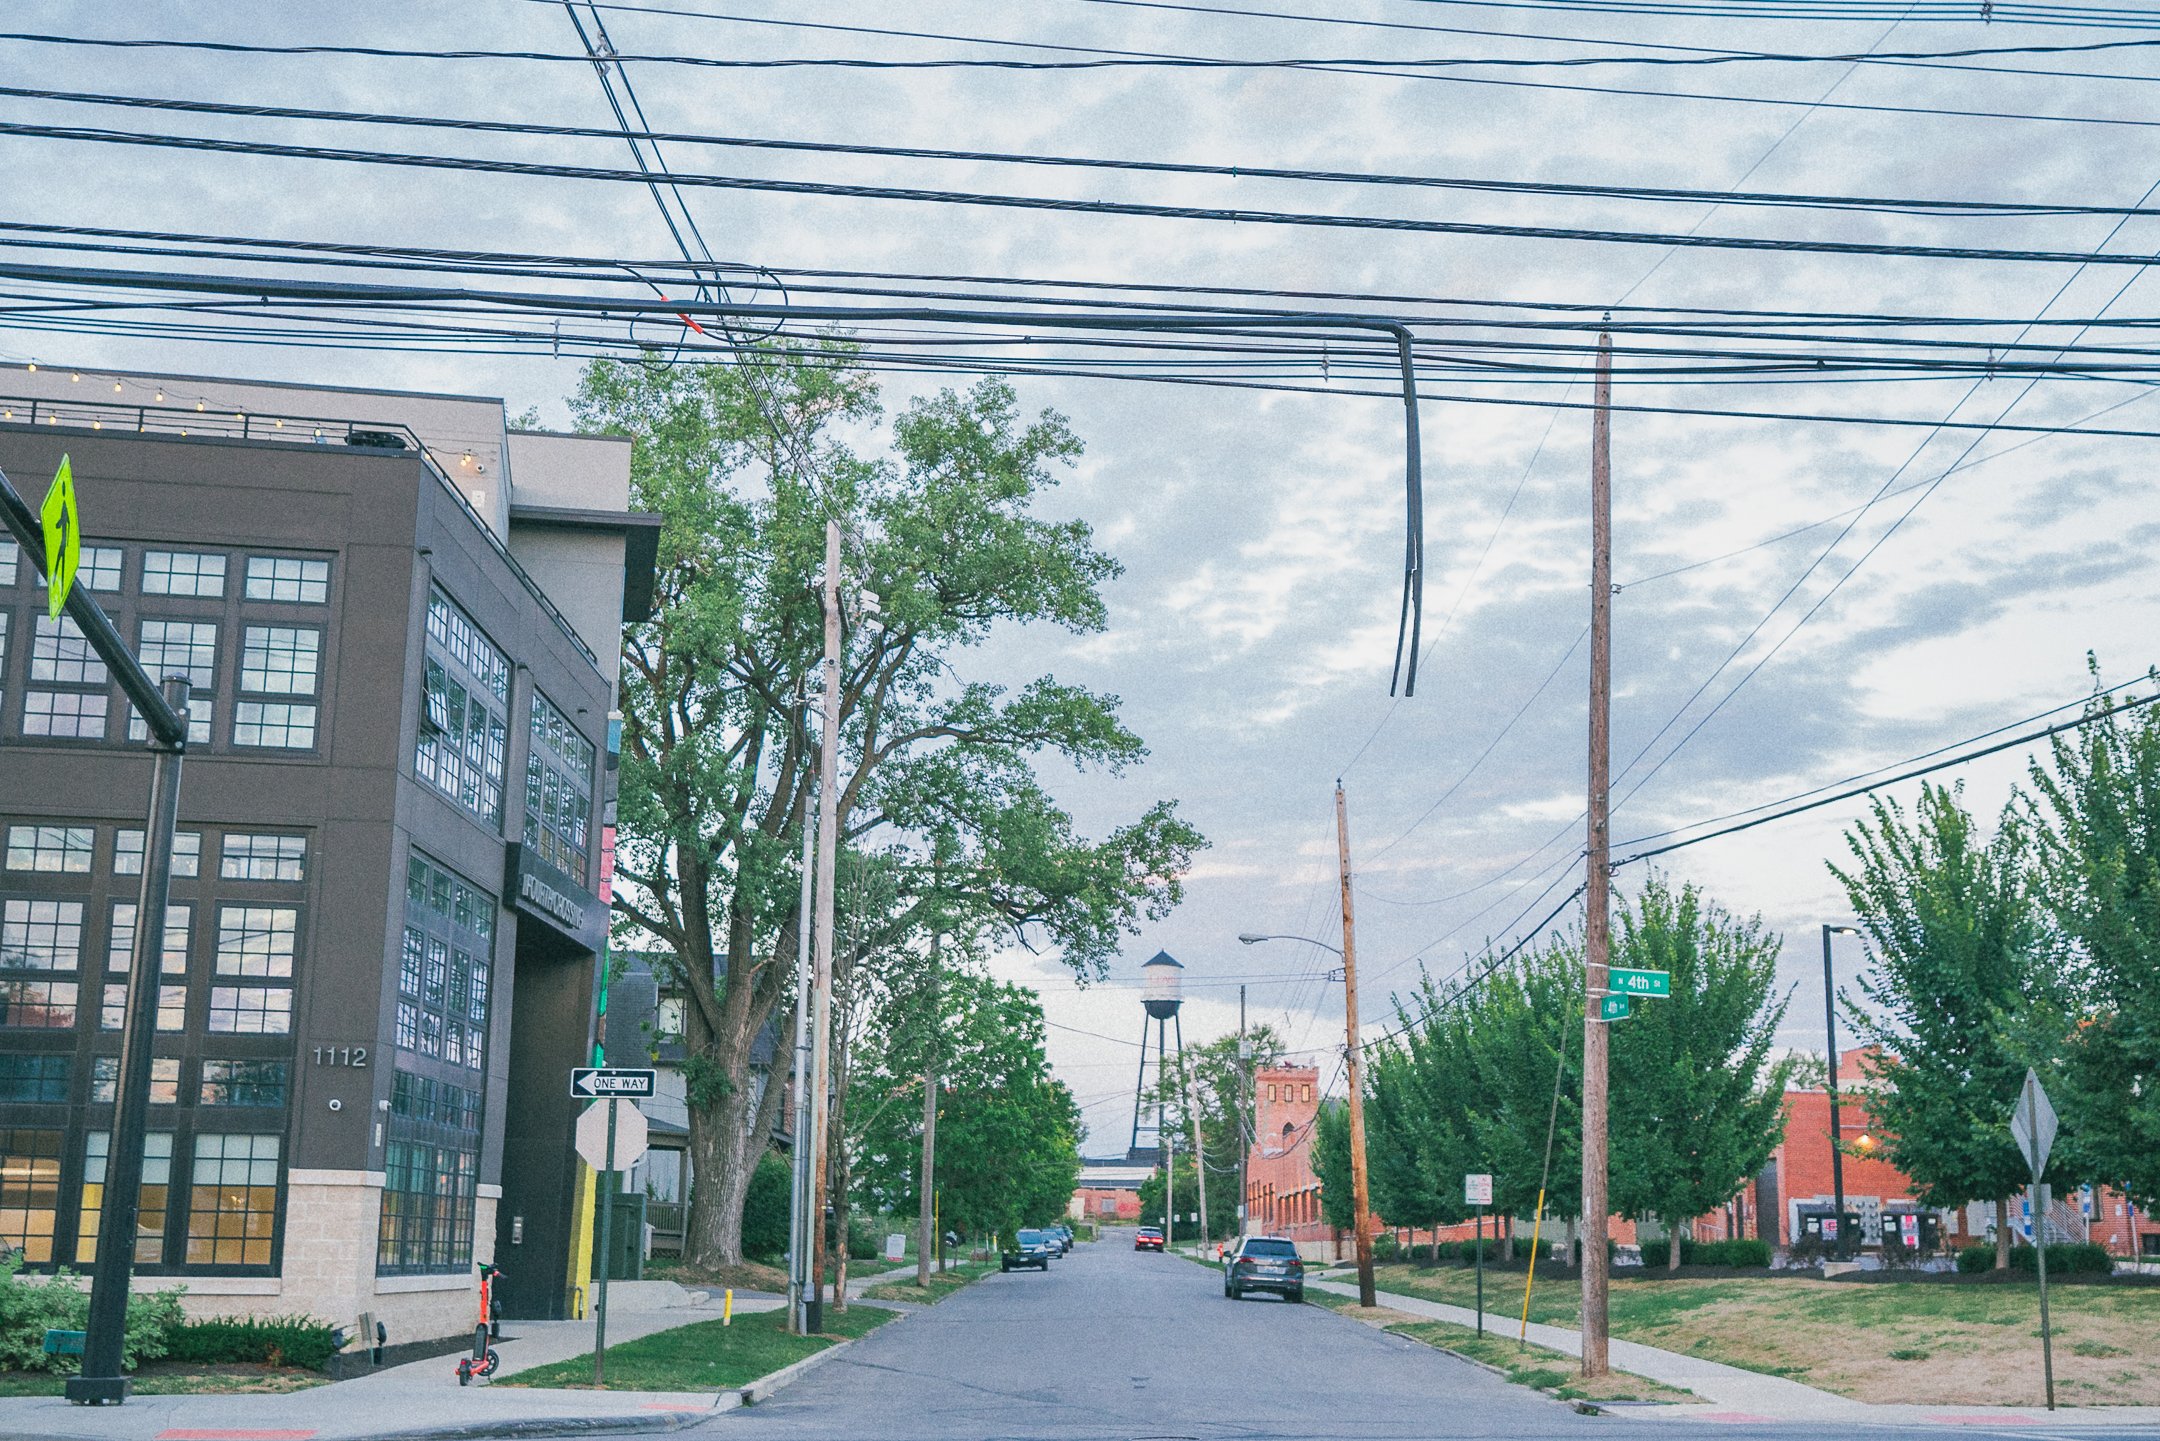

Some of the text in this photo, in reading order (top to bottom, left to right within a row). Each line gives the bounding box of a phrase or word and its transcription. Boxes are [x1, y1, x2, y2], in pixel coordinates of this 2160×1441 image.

[1618, 977, 1624, 985] N
[1627, 975, 1649, 990] 4th
[313, 1046, 367, 1066] 1112
[594, 1078, 646, 1089] ONE WAY
